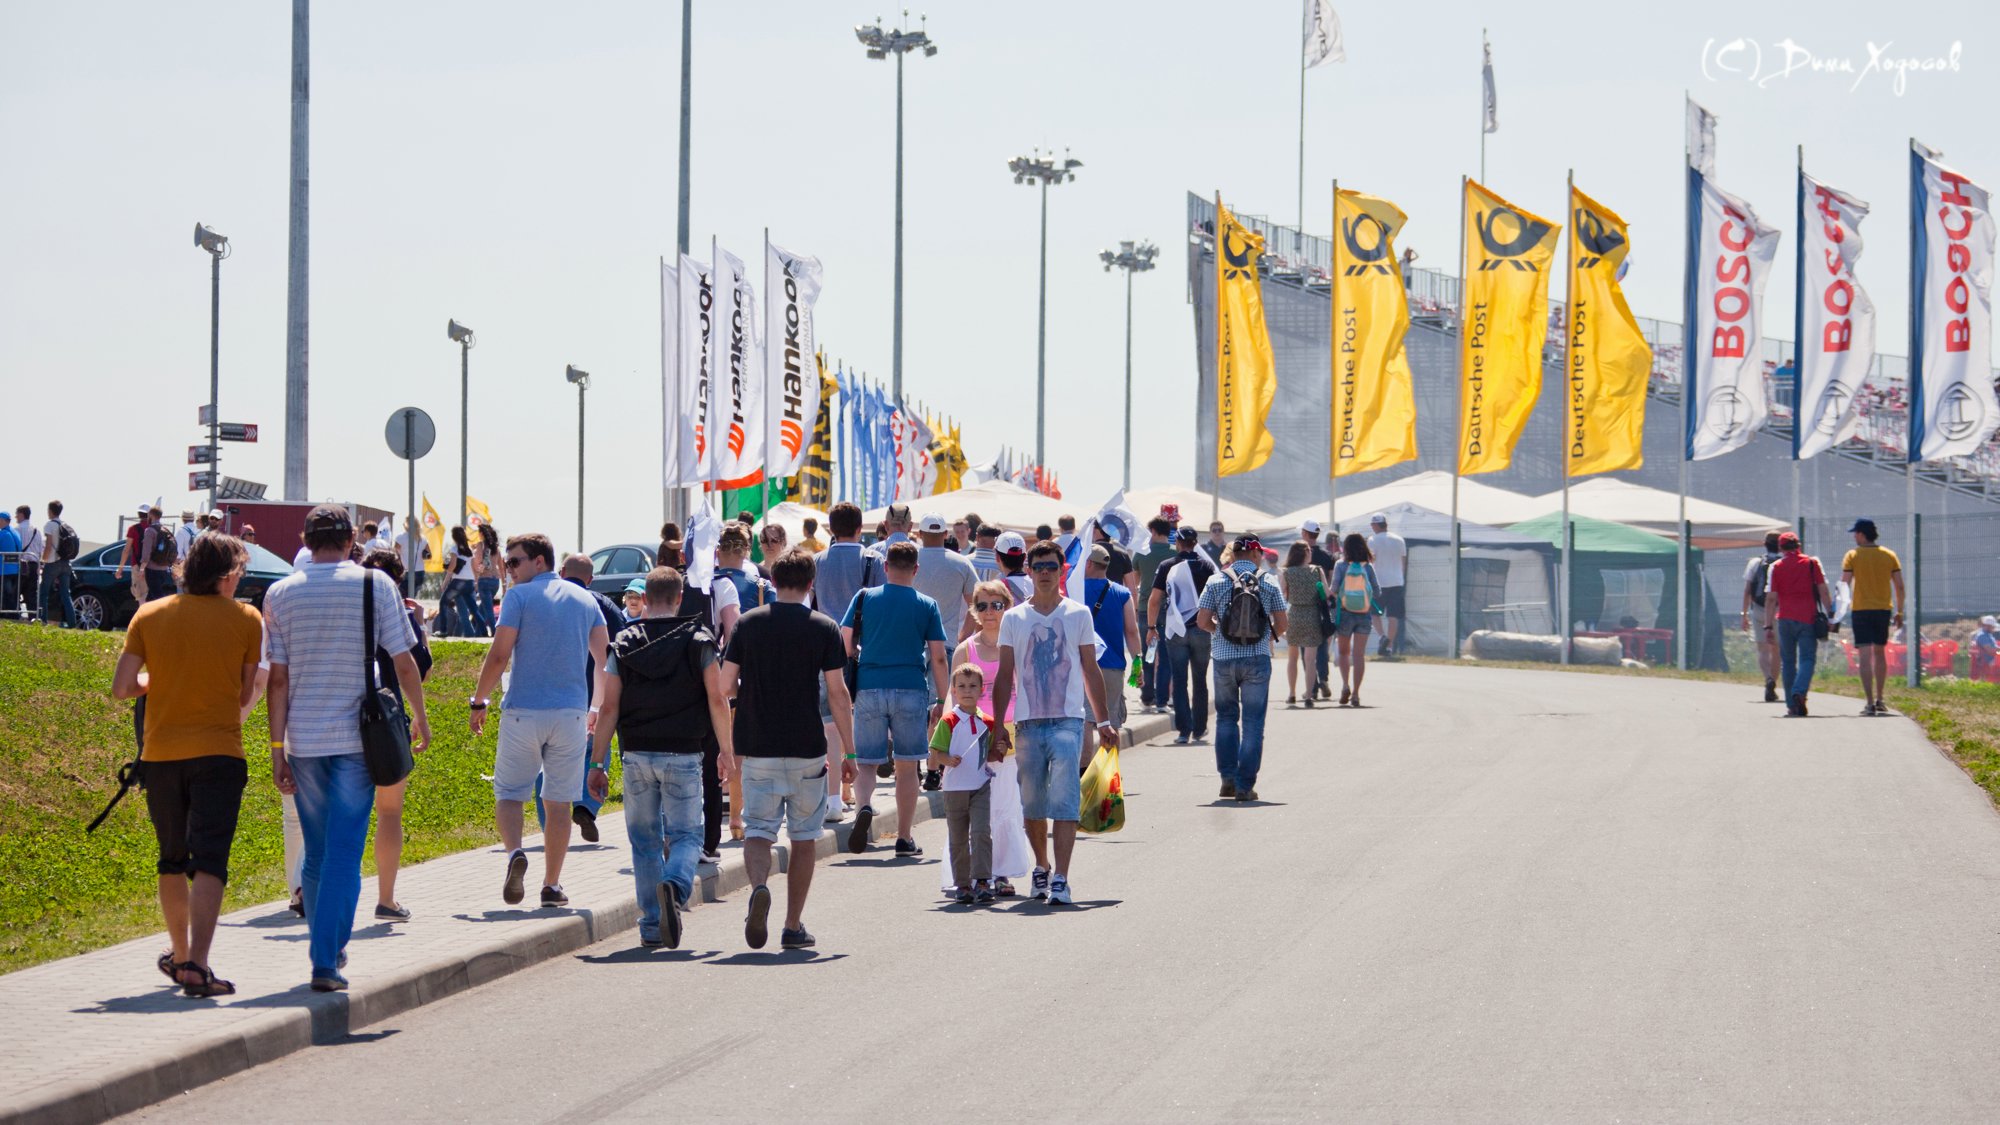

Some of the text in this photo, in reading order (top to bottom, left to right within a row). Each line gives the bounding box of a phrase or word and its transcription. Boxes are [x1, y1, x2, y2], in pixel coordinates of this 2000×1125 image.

[1938, 171, 1973, 352] BOSCH
[1339, 307, 1356, 459] Deutsche Post
[1468, 302, 1487, 456] Deutsche Post
[1571, 300, 1586, 458] Deutsche Post
